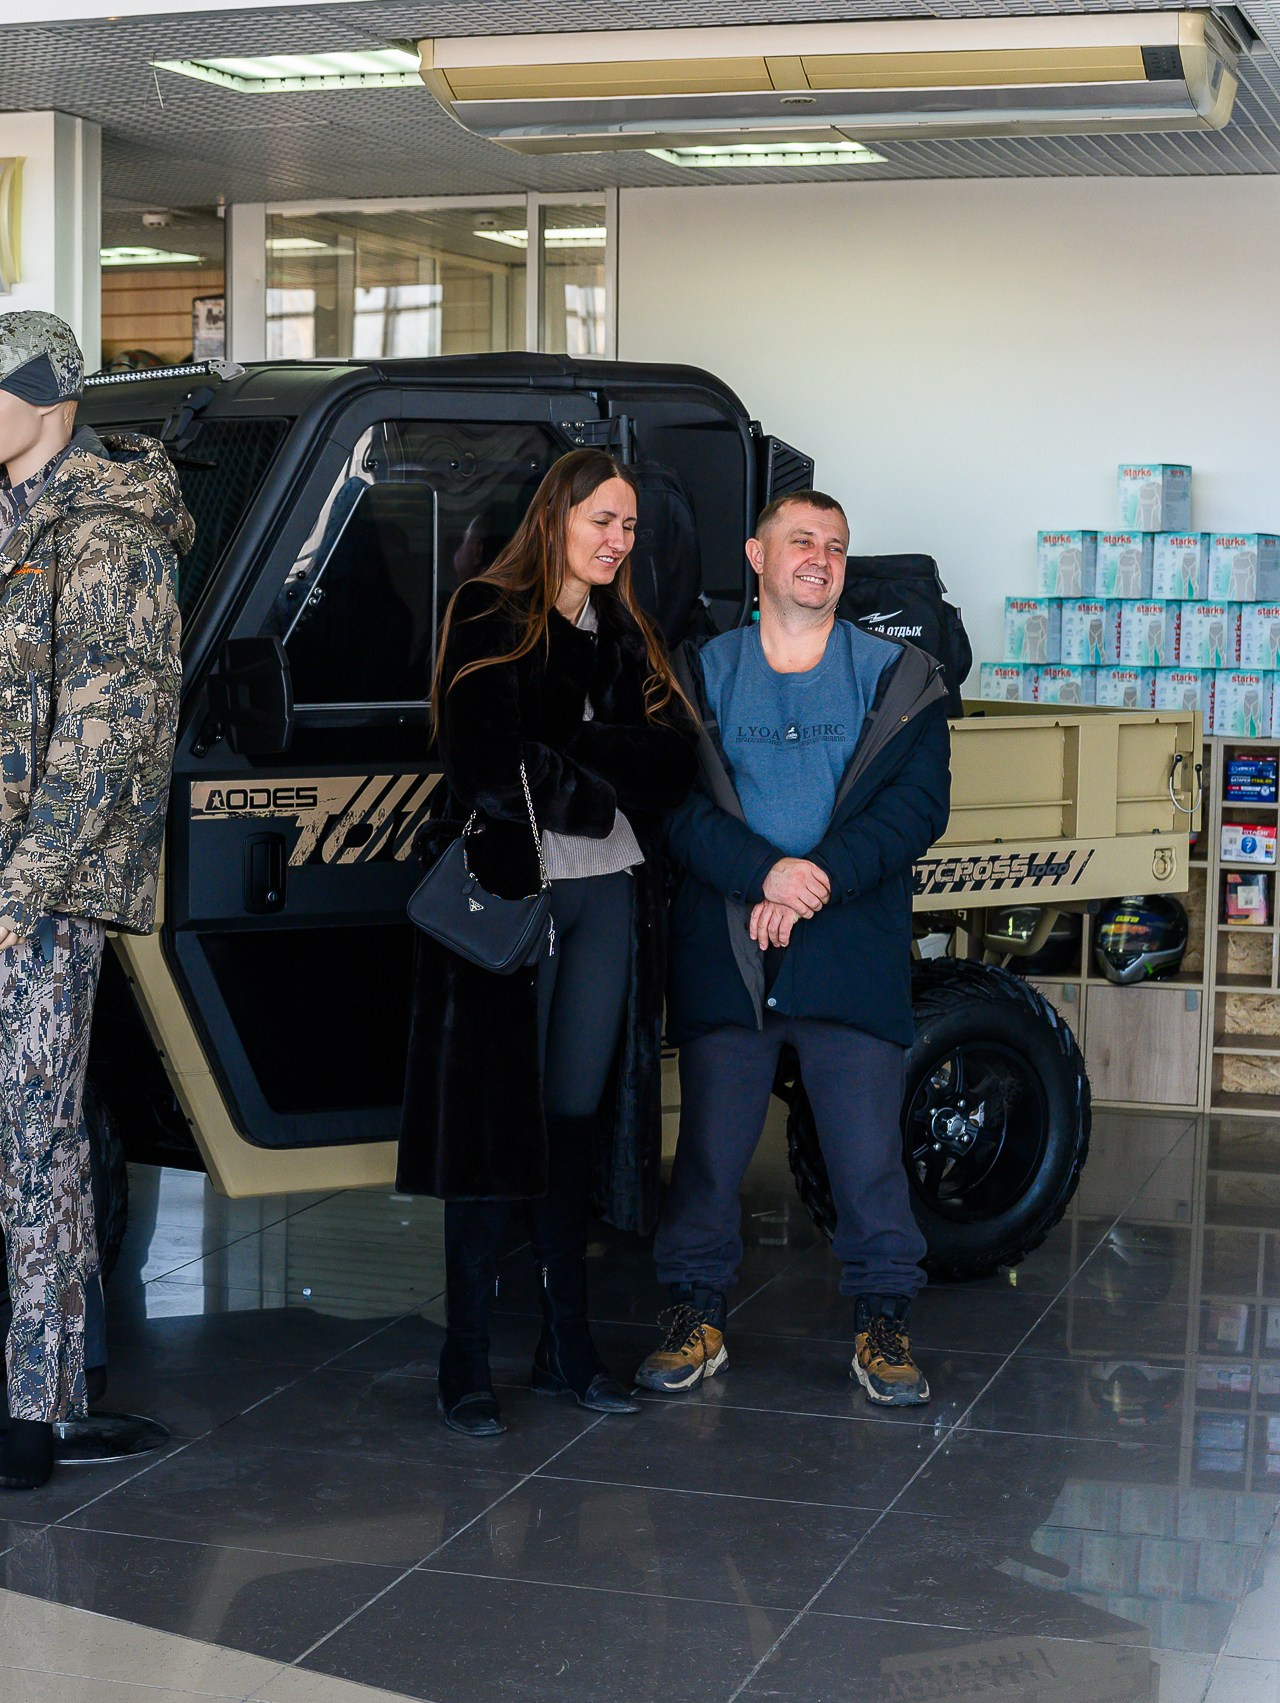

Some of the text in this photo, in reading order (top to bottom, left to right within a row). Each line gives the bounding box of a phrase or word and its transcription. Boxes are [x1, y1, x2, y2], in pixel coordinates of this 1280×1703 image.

[1170, 536, 1198, 546] starks
[1216, 536, 1246, 547] starks
[1257, 607, 1280, 616] stark
[886, 626, 923, 638] ОТДЫХ
[1171, 673, 1198, 682] starks
[1231, 674, 1260, 684] starks
[205, 786, 319, 811] AODES
[912, 857, 1030, 884] TCROSS
[1030, 862, 1071, 877] 1000
